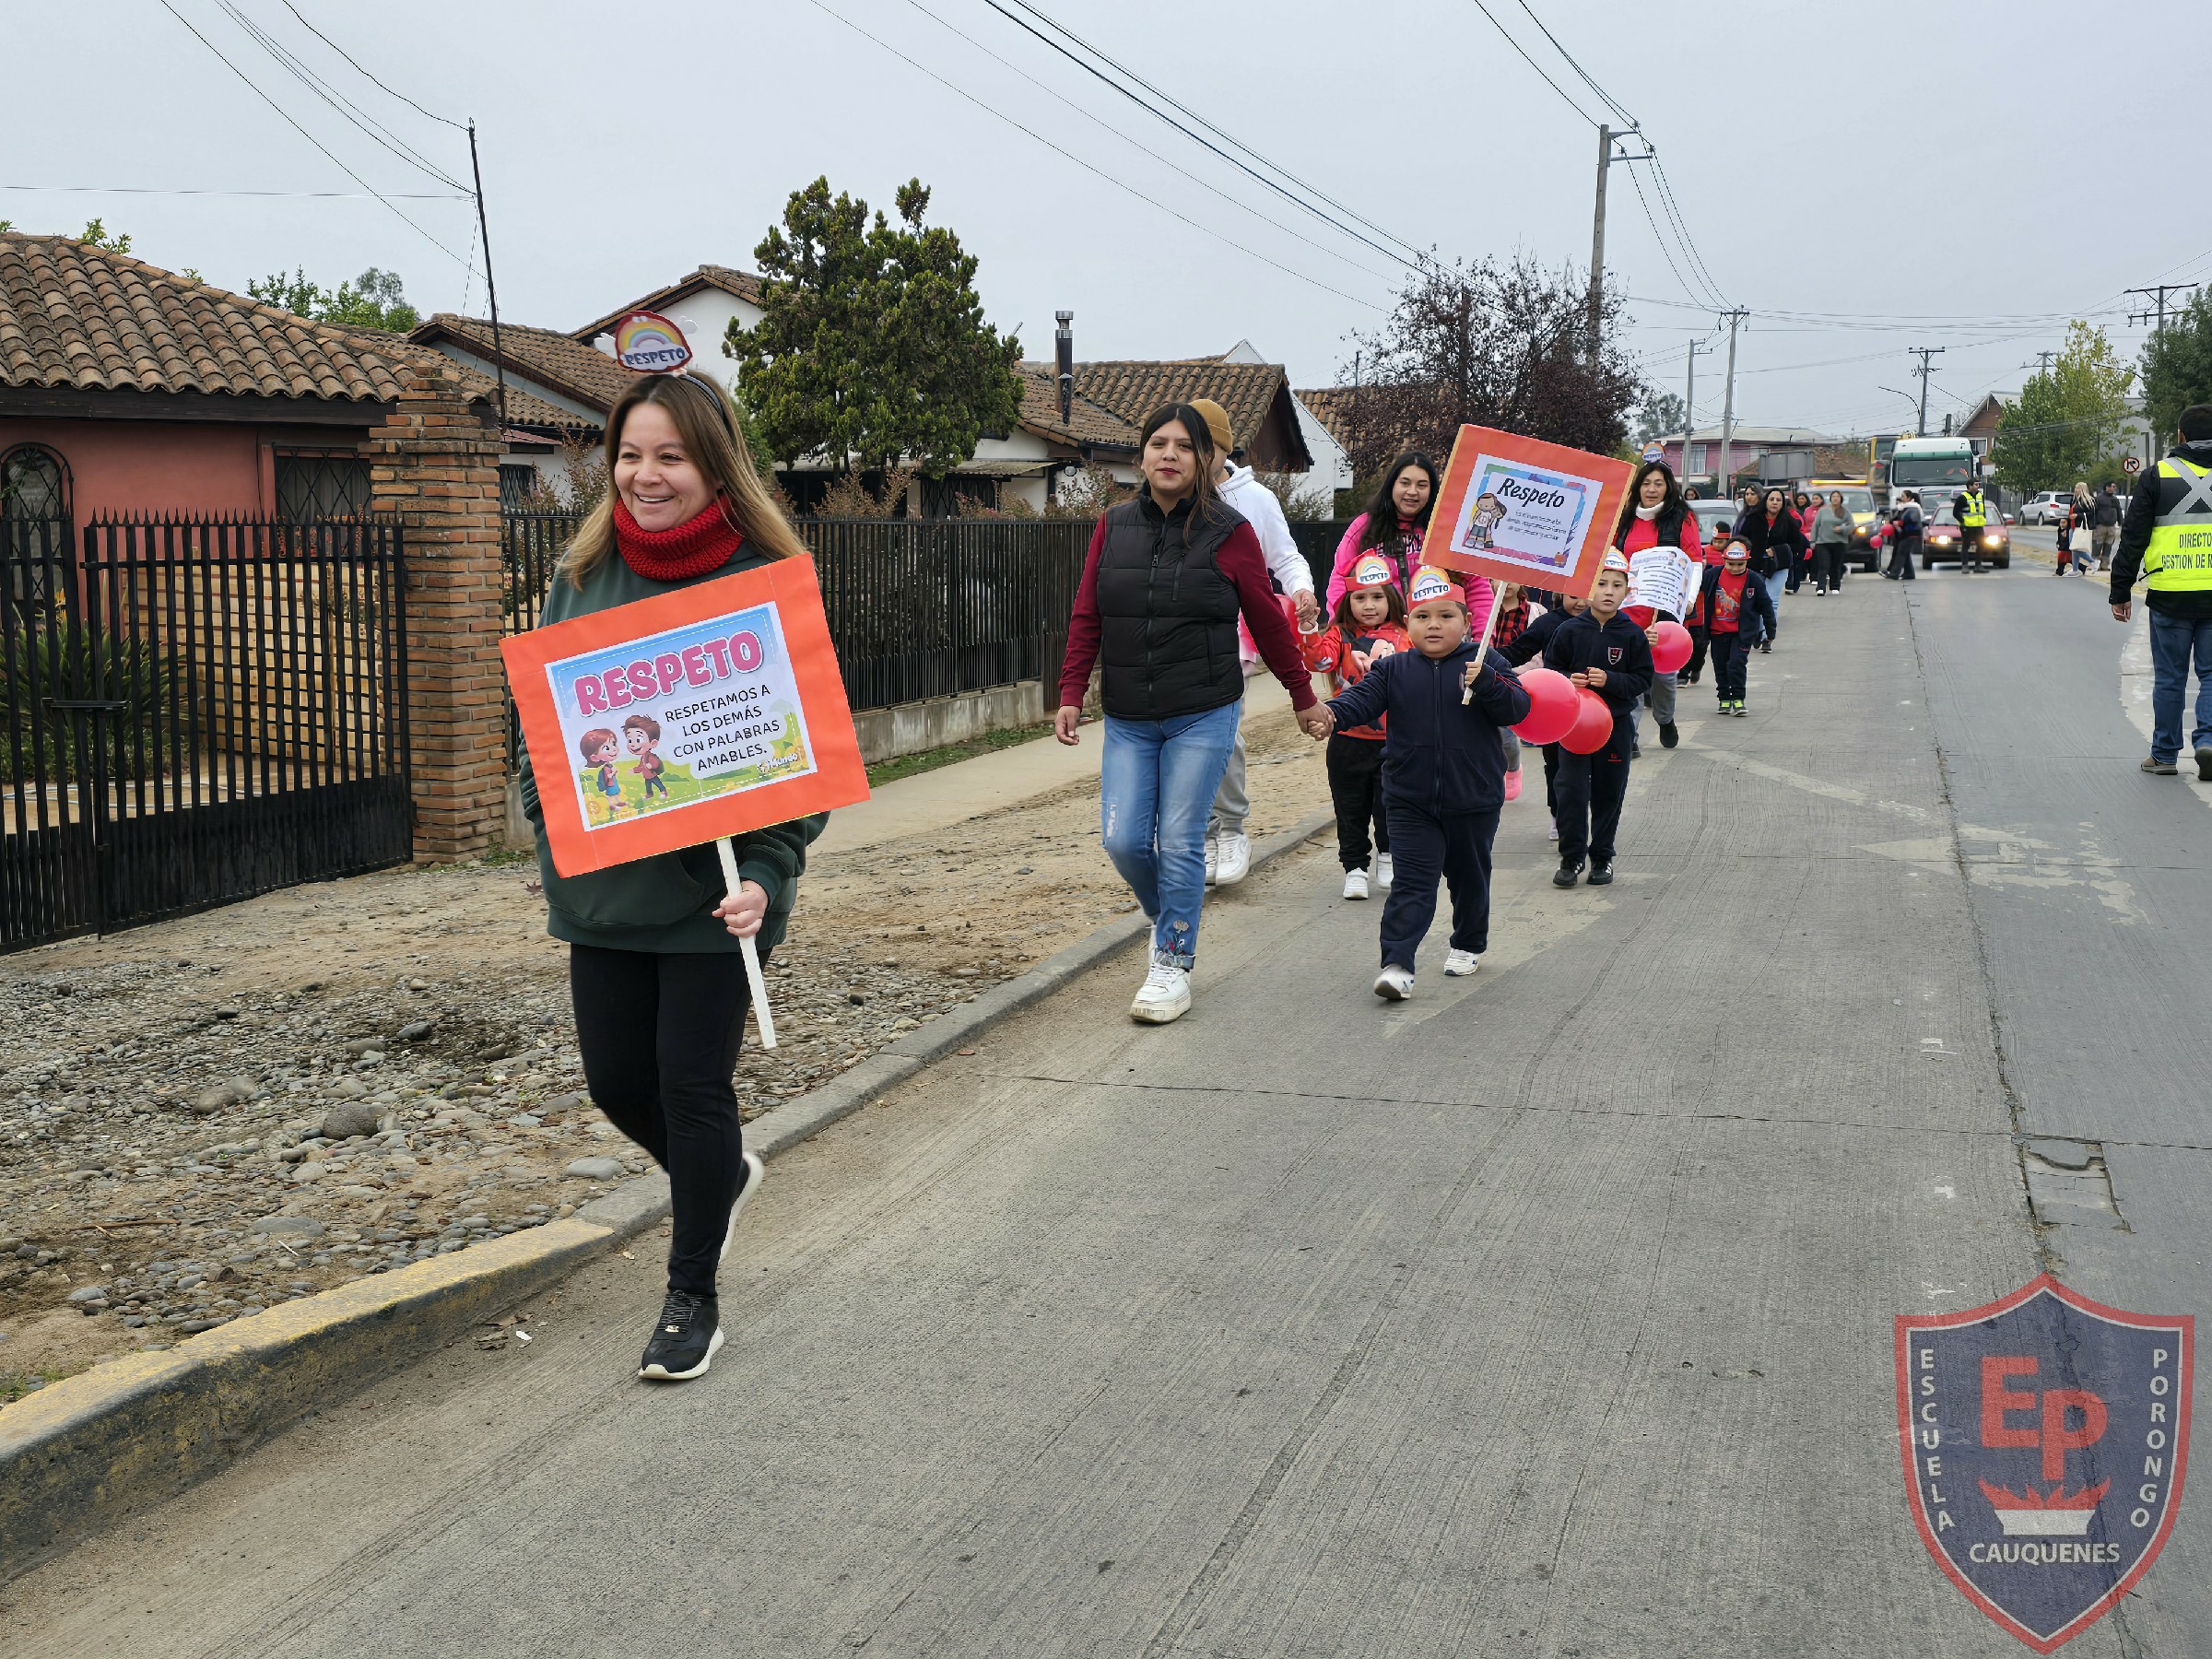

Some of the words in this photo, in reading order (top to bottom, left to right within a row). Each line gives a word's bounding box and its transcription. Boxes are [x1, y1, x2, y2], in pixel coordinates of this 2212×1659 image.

[624, 347, 686, 366] RESPETO
[1497, 477, 1565, 508] Respeto
[2195, 554, 2206, 568] DE
[573, 629, 764, 718] RESPETO
[665, 688, 758, 722] RESPETAMOS
[761, 684, 771, 697] A
[682, 720, 711, 737] LOS
[712, 705, 762, 728] DEMÁS
[674, 740, 705, 758] CON
[708, 720, 780, 748] PALABRAS
[698, 743, 767, 771] AMABLES.
